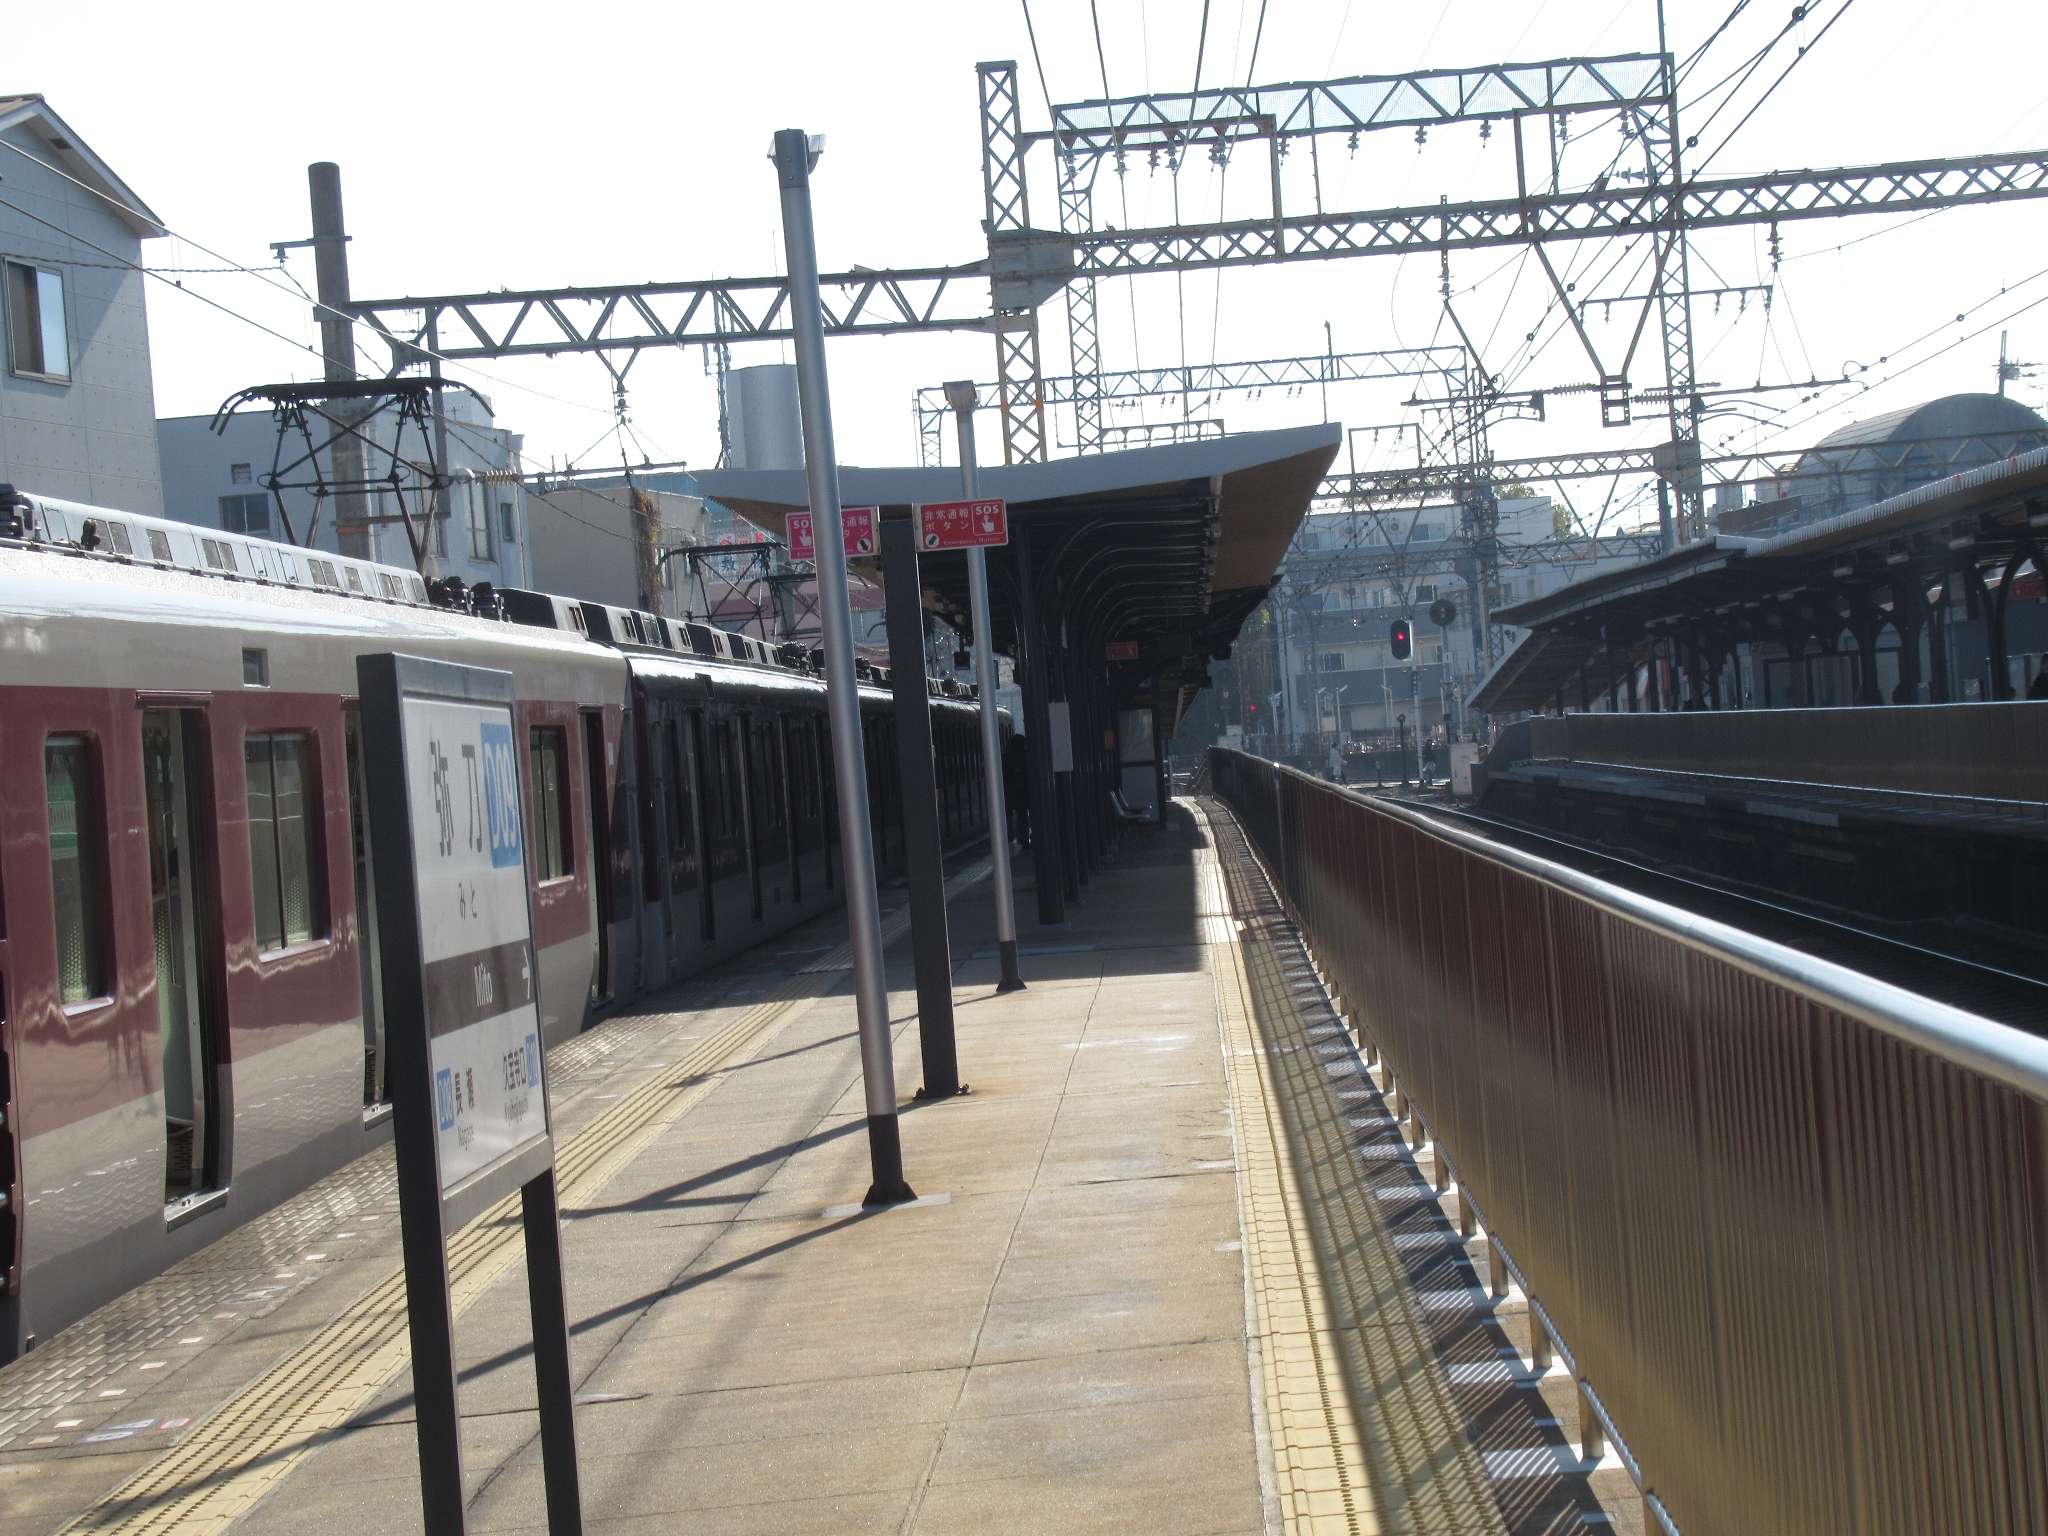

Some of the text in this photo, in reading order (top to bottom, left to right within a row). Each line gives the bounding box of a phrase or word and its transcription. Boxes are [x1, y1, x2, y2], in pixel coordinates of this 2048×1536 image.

[793, 519, 812, 529] SO
[924, 508, 969, 521] 非常通報
[975, 504, 999, 515] SOS
[430, 740, 483, 857] 弥刀
[484, 742, 516, 849] D09
[459, 880, 477, 921] みと
[474, 962, 494, 1008] Mito
